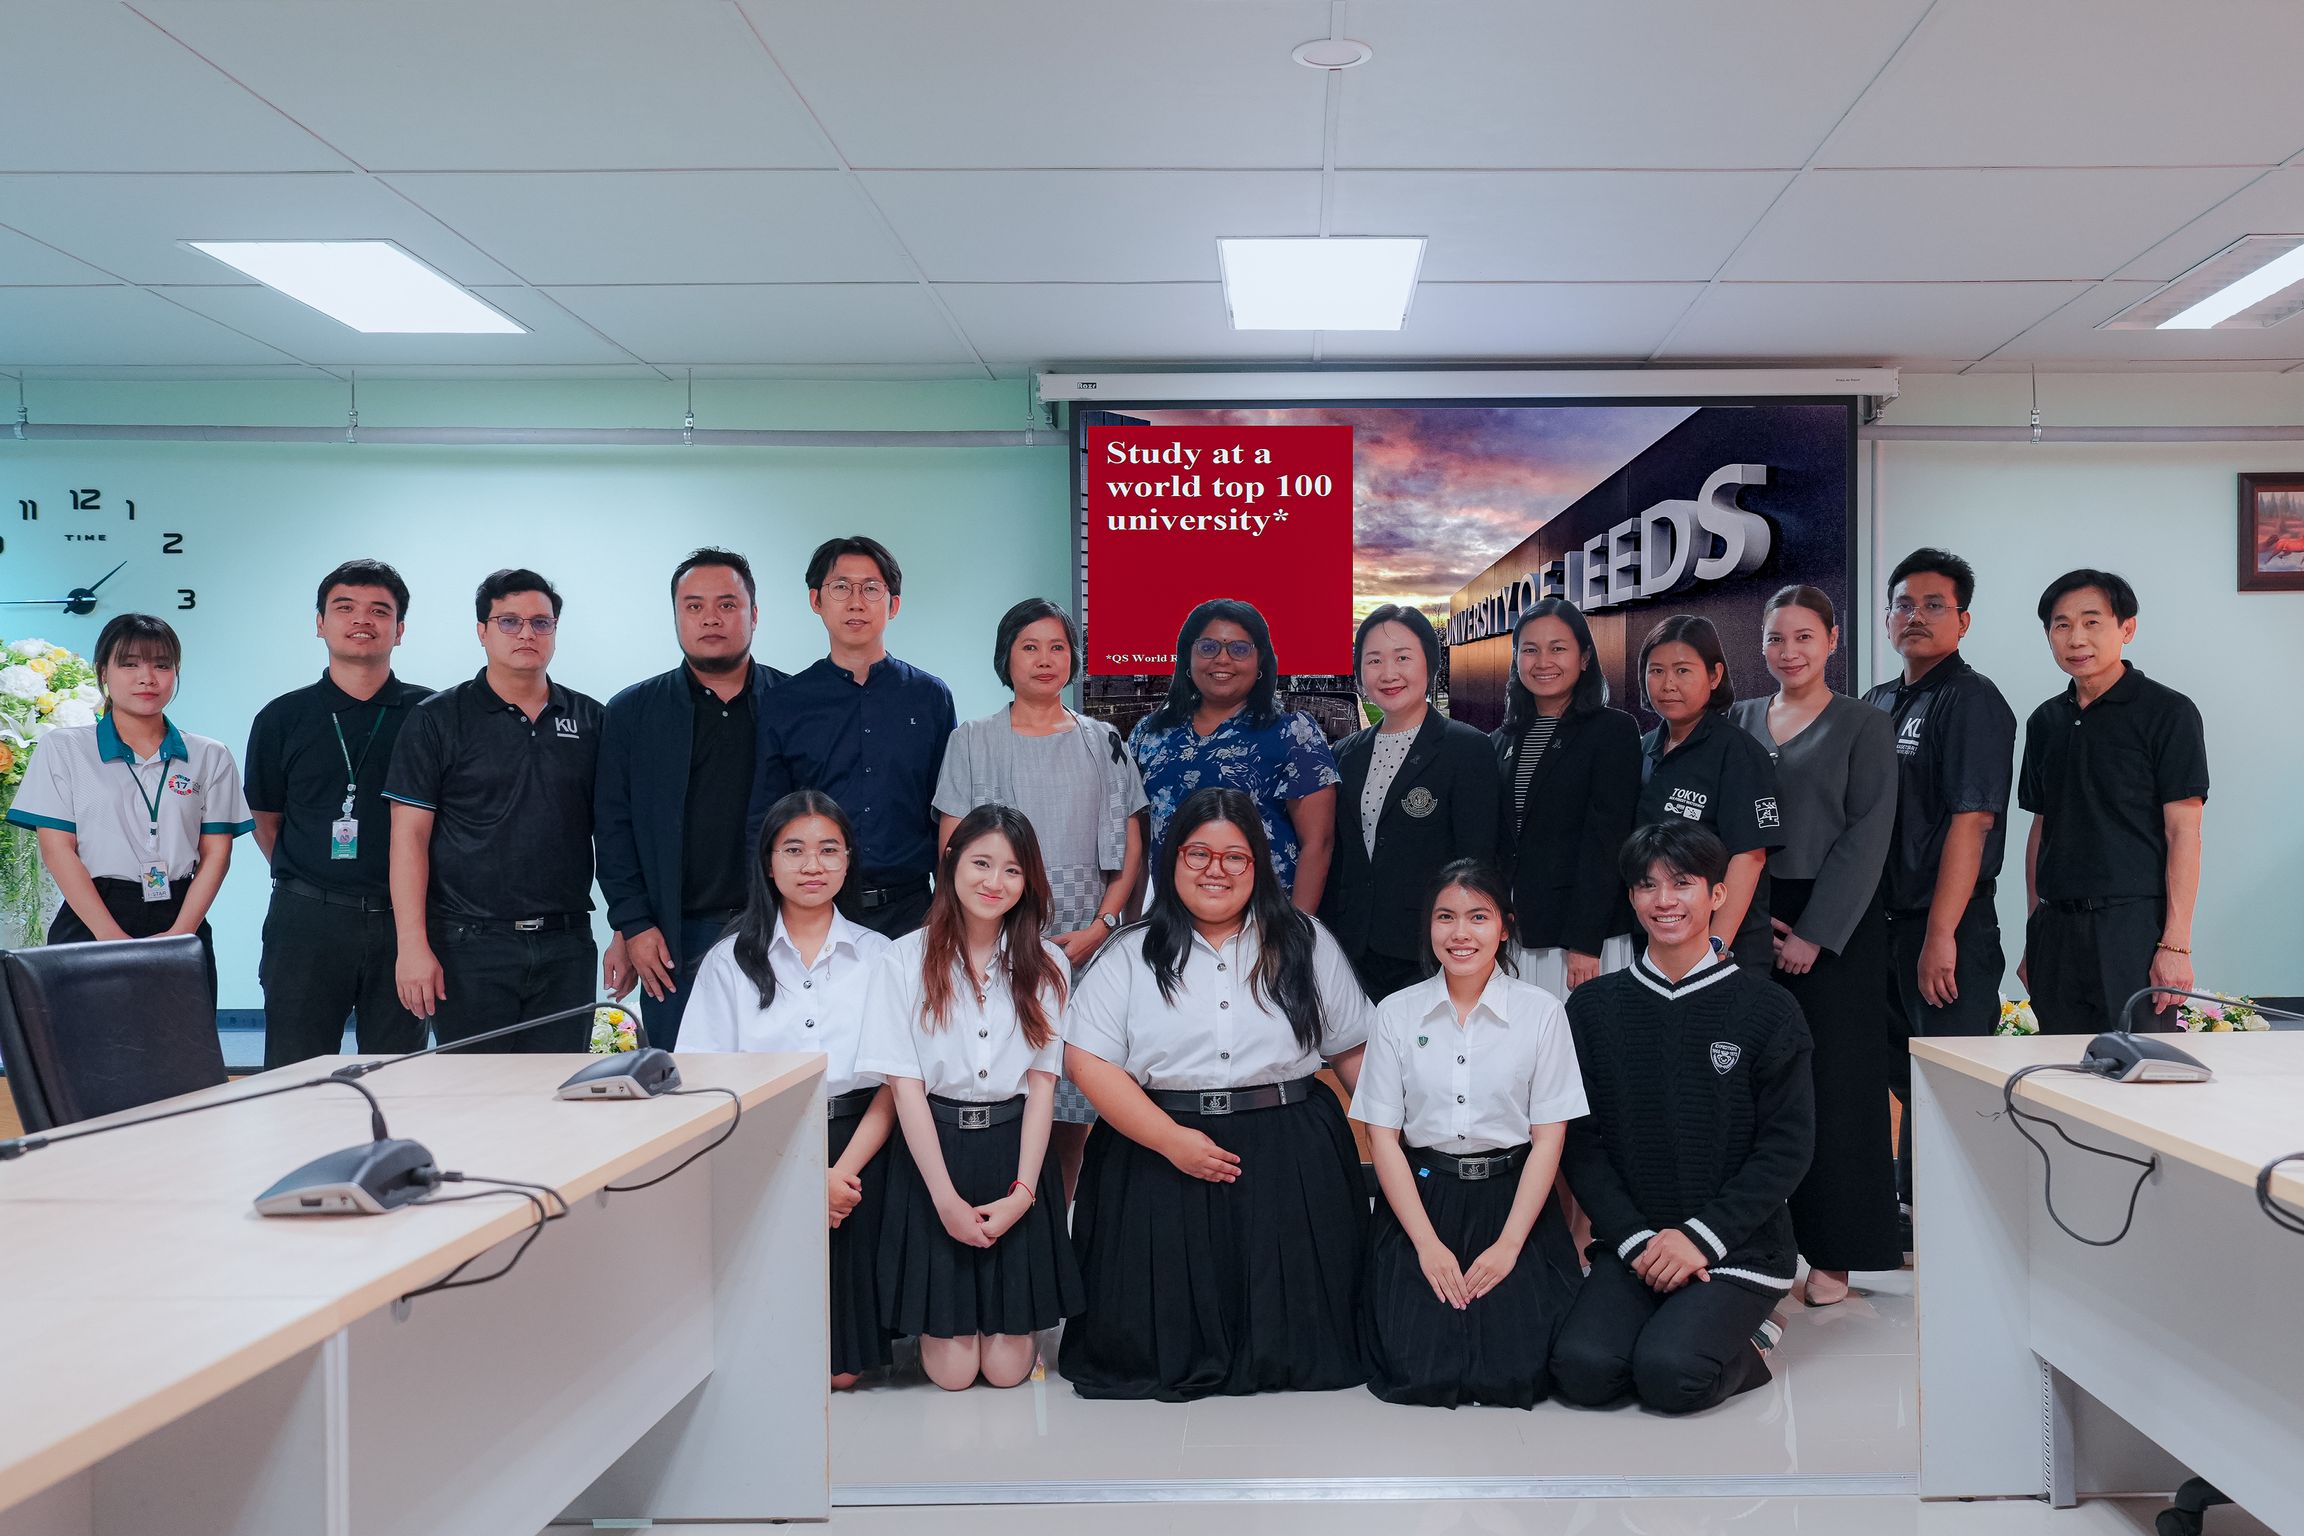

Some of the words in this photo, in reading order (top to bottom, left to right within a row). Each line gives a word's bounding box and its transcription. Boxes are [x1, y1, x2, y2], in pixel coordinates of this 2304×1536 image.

[1106, 441, 1202, 470] Study
[1212, 444, 1244, 464] at
[1254, 447, 1272, 464] a
[1106, 475, 1202, 498] world
[1211, 477, 1265, 504] top
[1276, 474, 1332, 497] 100
[19, 499, 38, 520] 11
[69, 489, 101, 510] 12
[126, 500, 135, 520] 1
[64, 534, 107, 542] TIME
[162, 533, 183, 554] 2
[1445, 582, 1520, 646] UNIVERSITY
[1518, 560, 1564, 616] OF
[1564, 463, 1771, 613] LEEDS
[177, 589, 196, 609] 3
[1132, 654, 1168, 662] World
[555, 717, 578, 734] KU
[175, 781, 188, 789] 17
[1672, 787, 1708, 805] TOKYO
